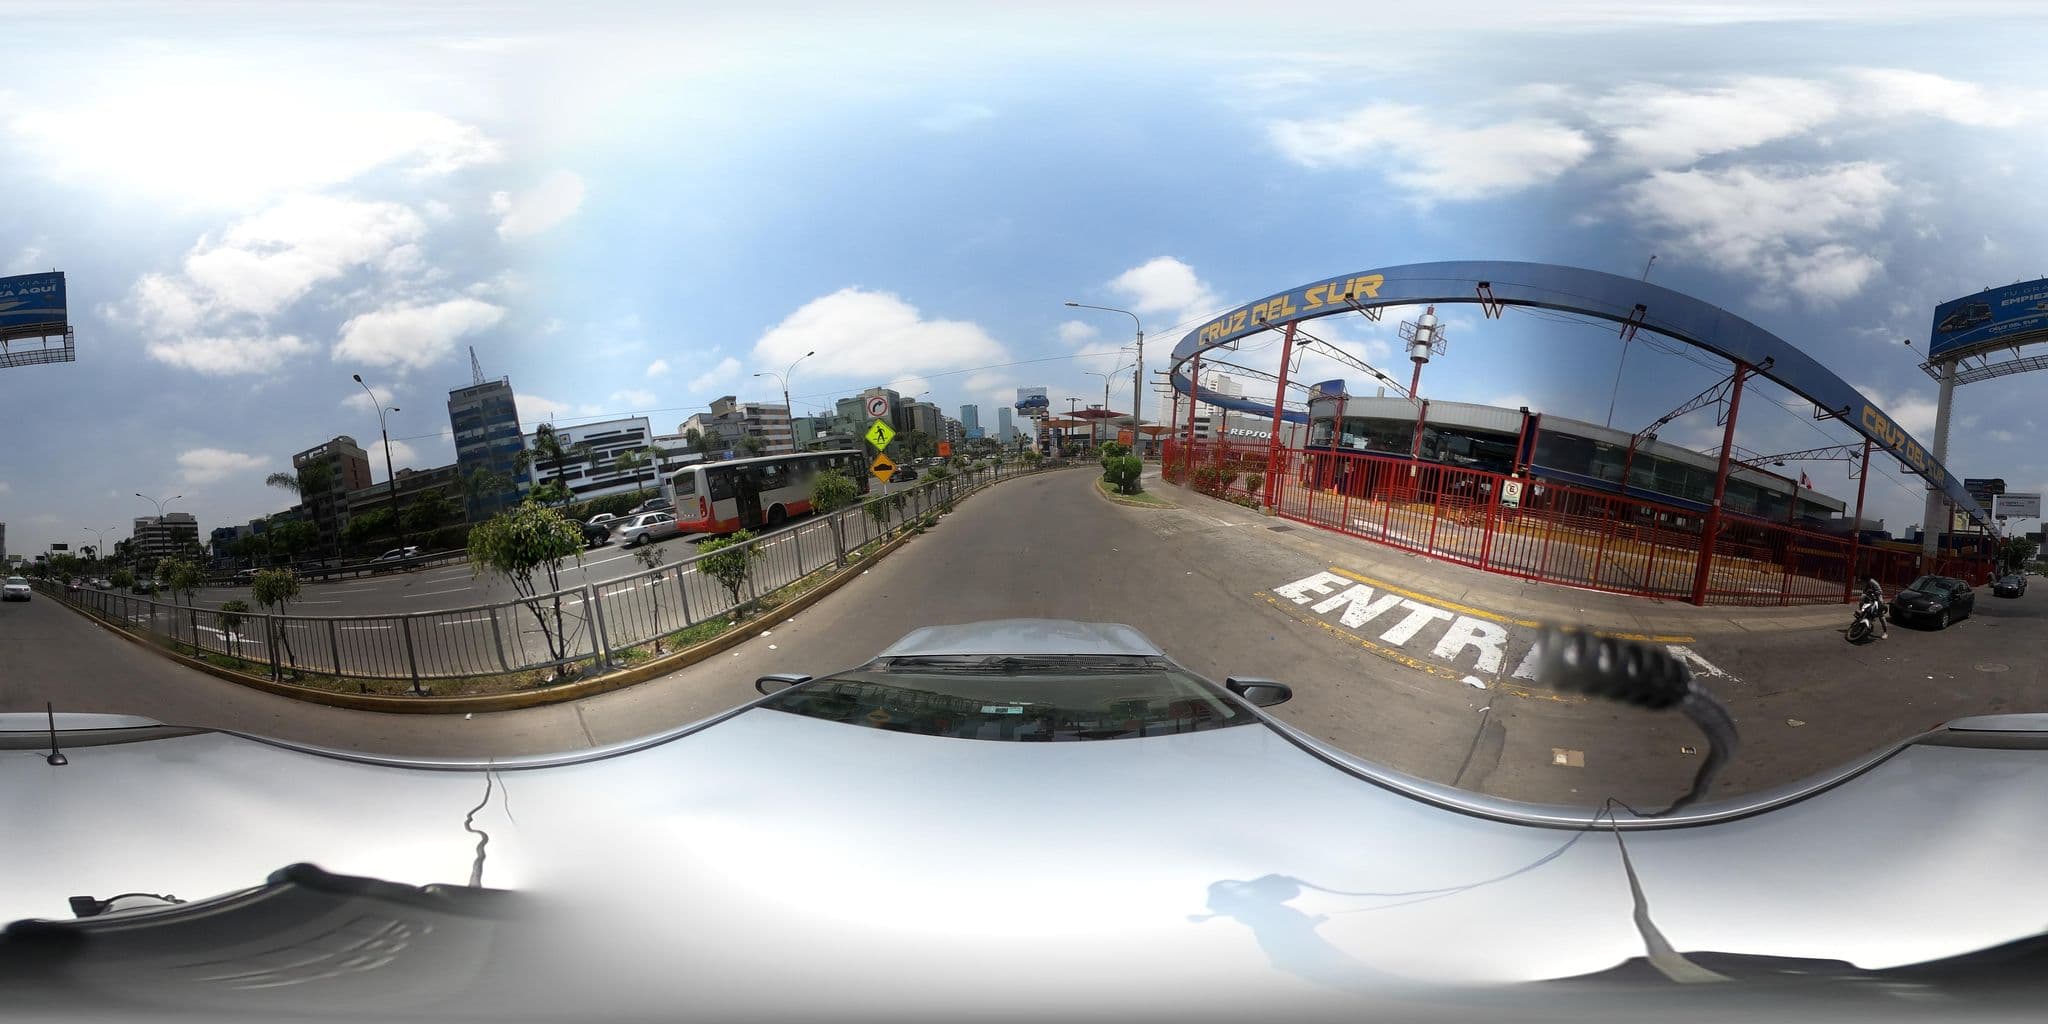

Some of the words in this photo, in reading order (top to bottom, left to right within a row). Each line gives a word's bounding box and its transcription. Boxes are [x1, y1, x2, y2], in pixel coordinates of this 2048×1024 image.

[17, 279, 57, 287] VIAJE
[1199, 310, 1248, 346] CRUZ
[1251, 295, 1296, 326] DEL
[1302, 274, 1385, 311] SUR
[1863, 405, 1905, 453] CRUZ
[1906, 441, 1925, 471] DEL
